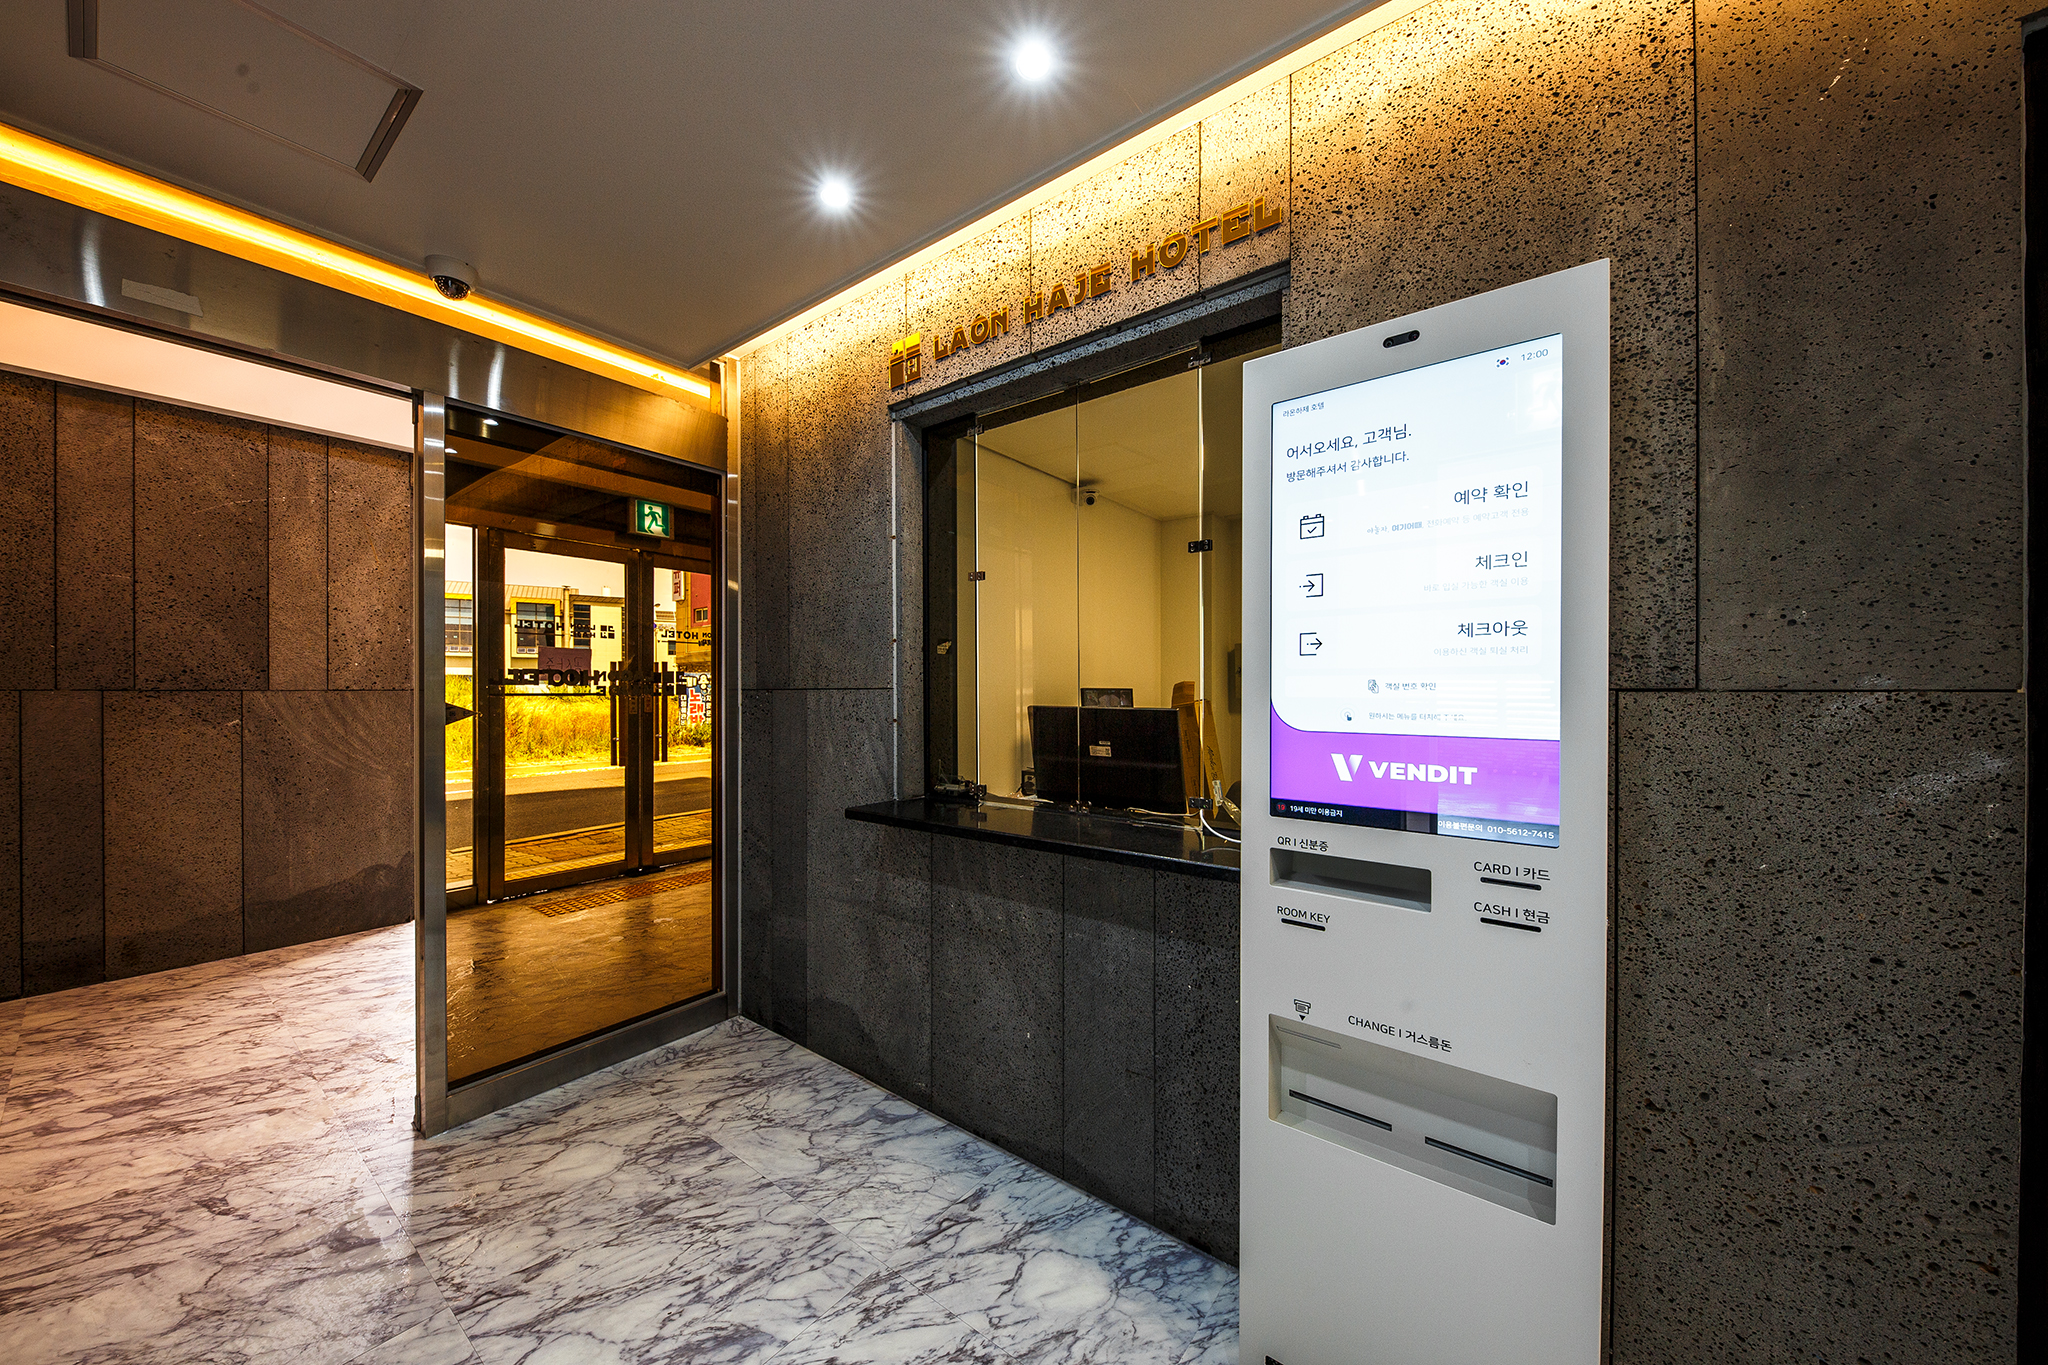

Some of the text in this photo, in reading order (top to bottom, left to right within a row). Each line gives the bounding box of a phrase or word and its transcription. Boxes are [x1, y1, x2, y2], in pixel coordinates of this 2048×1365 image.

[934, 197, 1282, 360] LAON HAJE HOTEL
[1521, 349, 1549, 361] 12:00
[1287, 424, 1412, 459] 어서오세요, 고객님.
[1287, 450, 1410, 482] 방문해주셔서 감사합니다.
[1454, 481, 1529, 505] 예약 확인
[1475, 551, 1528, 570] 체크인
[1457, 620, 1528, 638] 체크아웃
[1368, 760, 1478, 785] VENDIT
[1487, 825, 1555, 839] 010-5612-7415
[1277, 836, 1329, 852] QR 신분증
[1473, 861, 1551, 881] CARD 카드
[1276, 905, 1331, 923] ROOM KEY
[1473, 901, 1551, 924] CASH 현금
[1348, 1015, 1452, 1052] CHANGE 거스름돈
